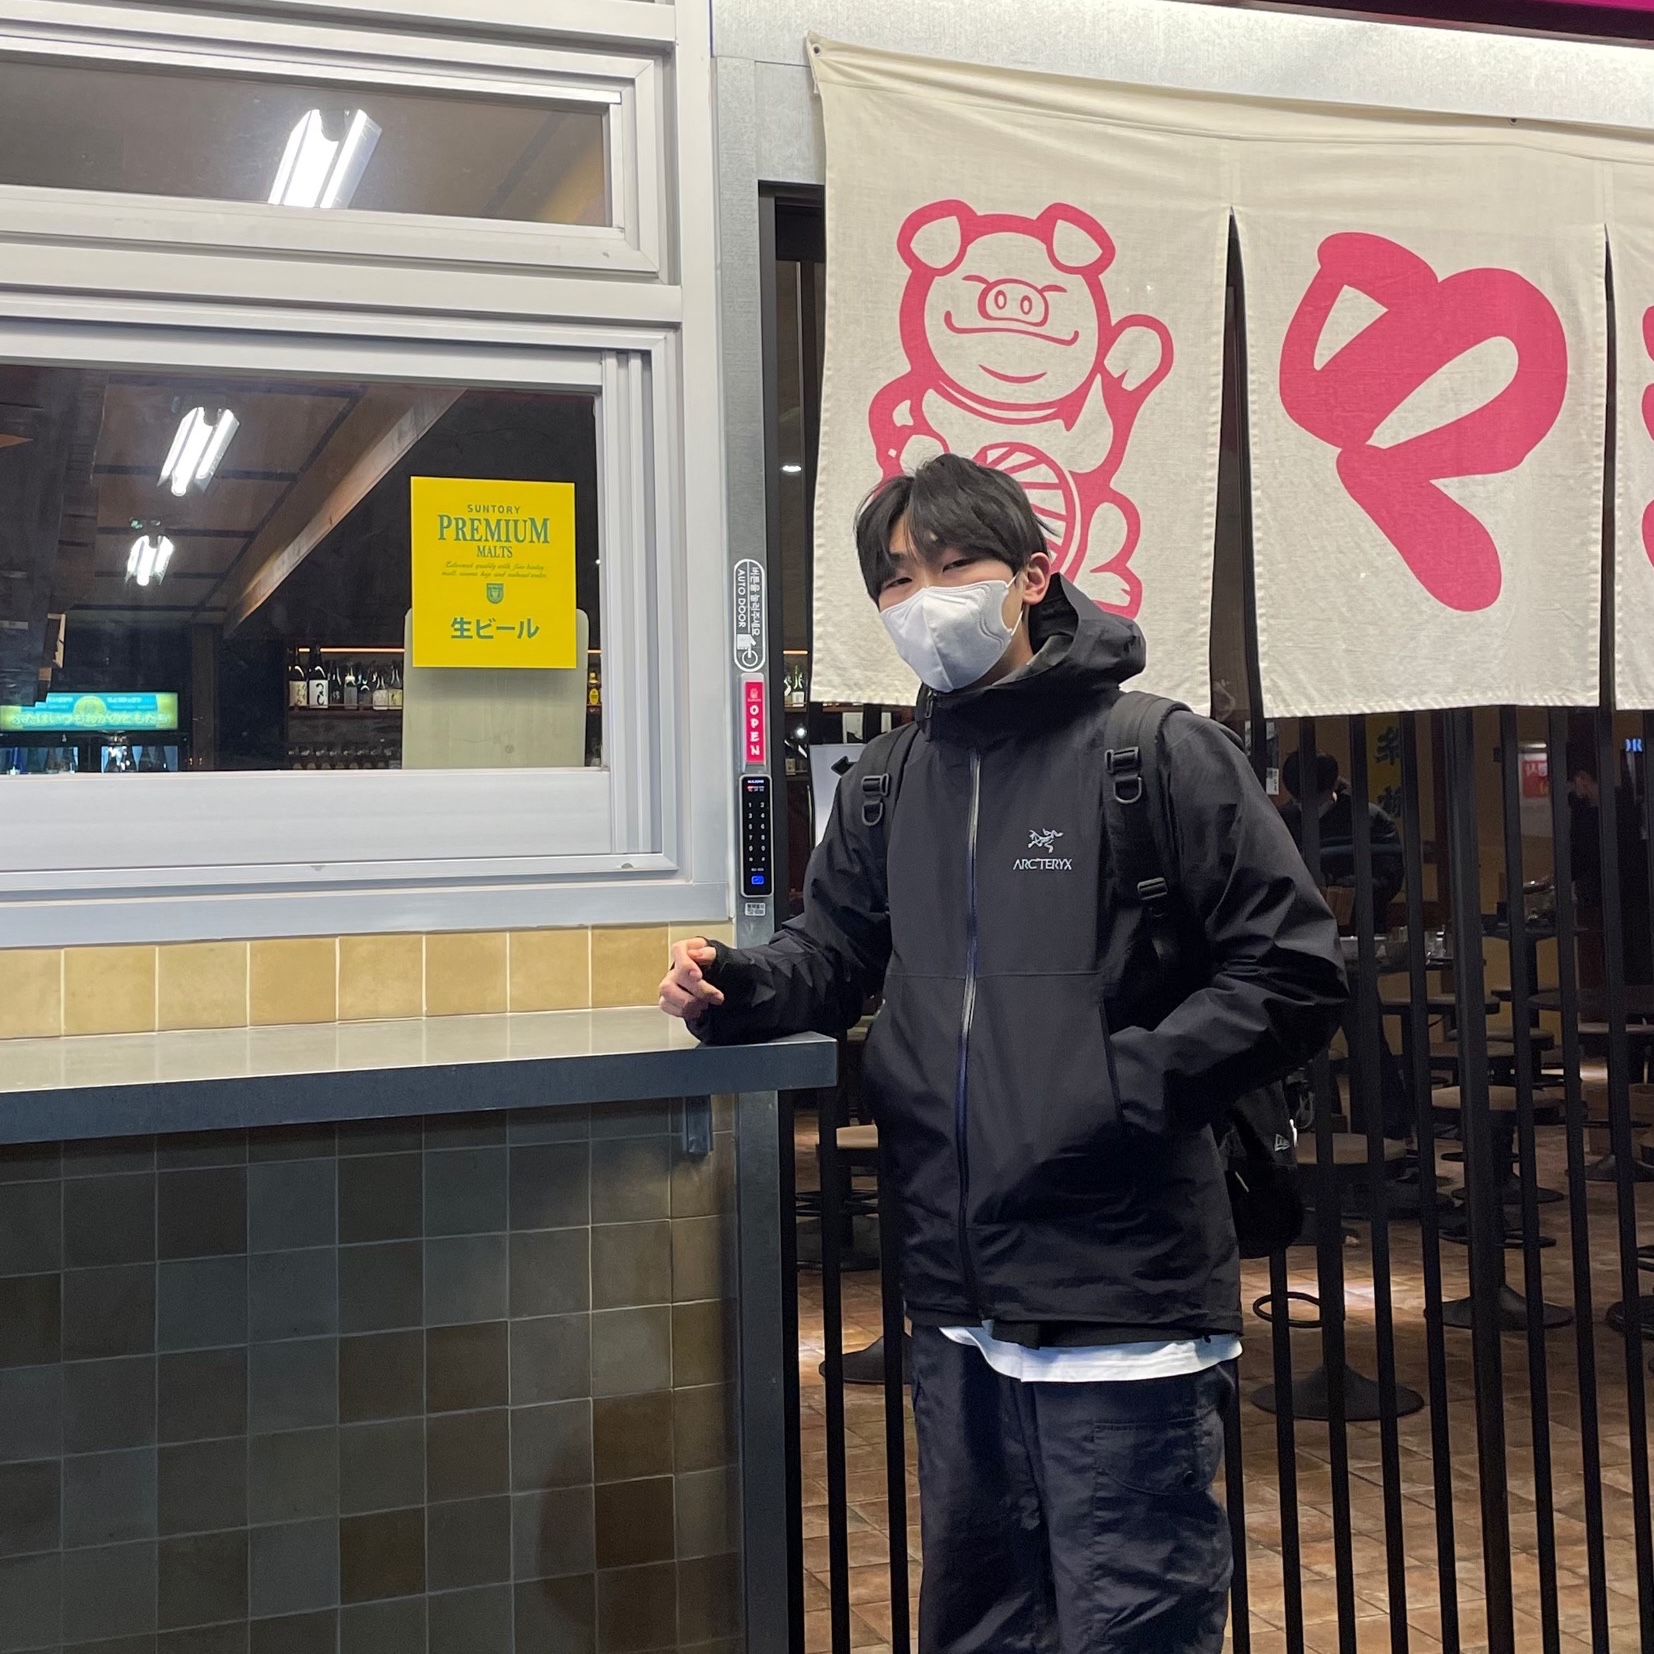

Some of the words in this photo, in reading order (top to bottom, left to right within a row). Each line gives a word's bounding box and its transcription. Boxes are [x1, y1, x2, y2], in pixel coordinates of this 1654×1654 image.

[467, 504, 521, 514] SUNTORY
[437, 515, 550, 543] PREMIUM
[738, 569, 746, 595] AUTO
[738, 598, 746, 628] DOOR
[450, 617, 540, 639] 生ビール
[749, 704, 760, 755] OPEN
